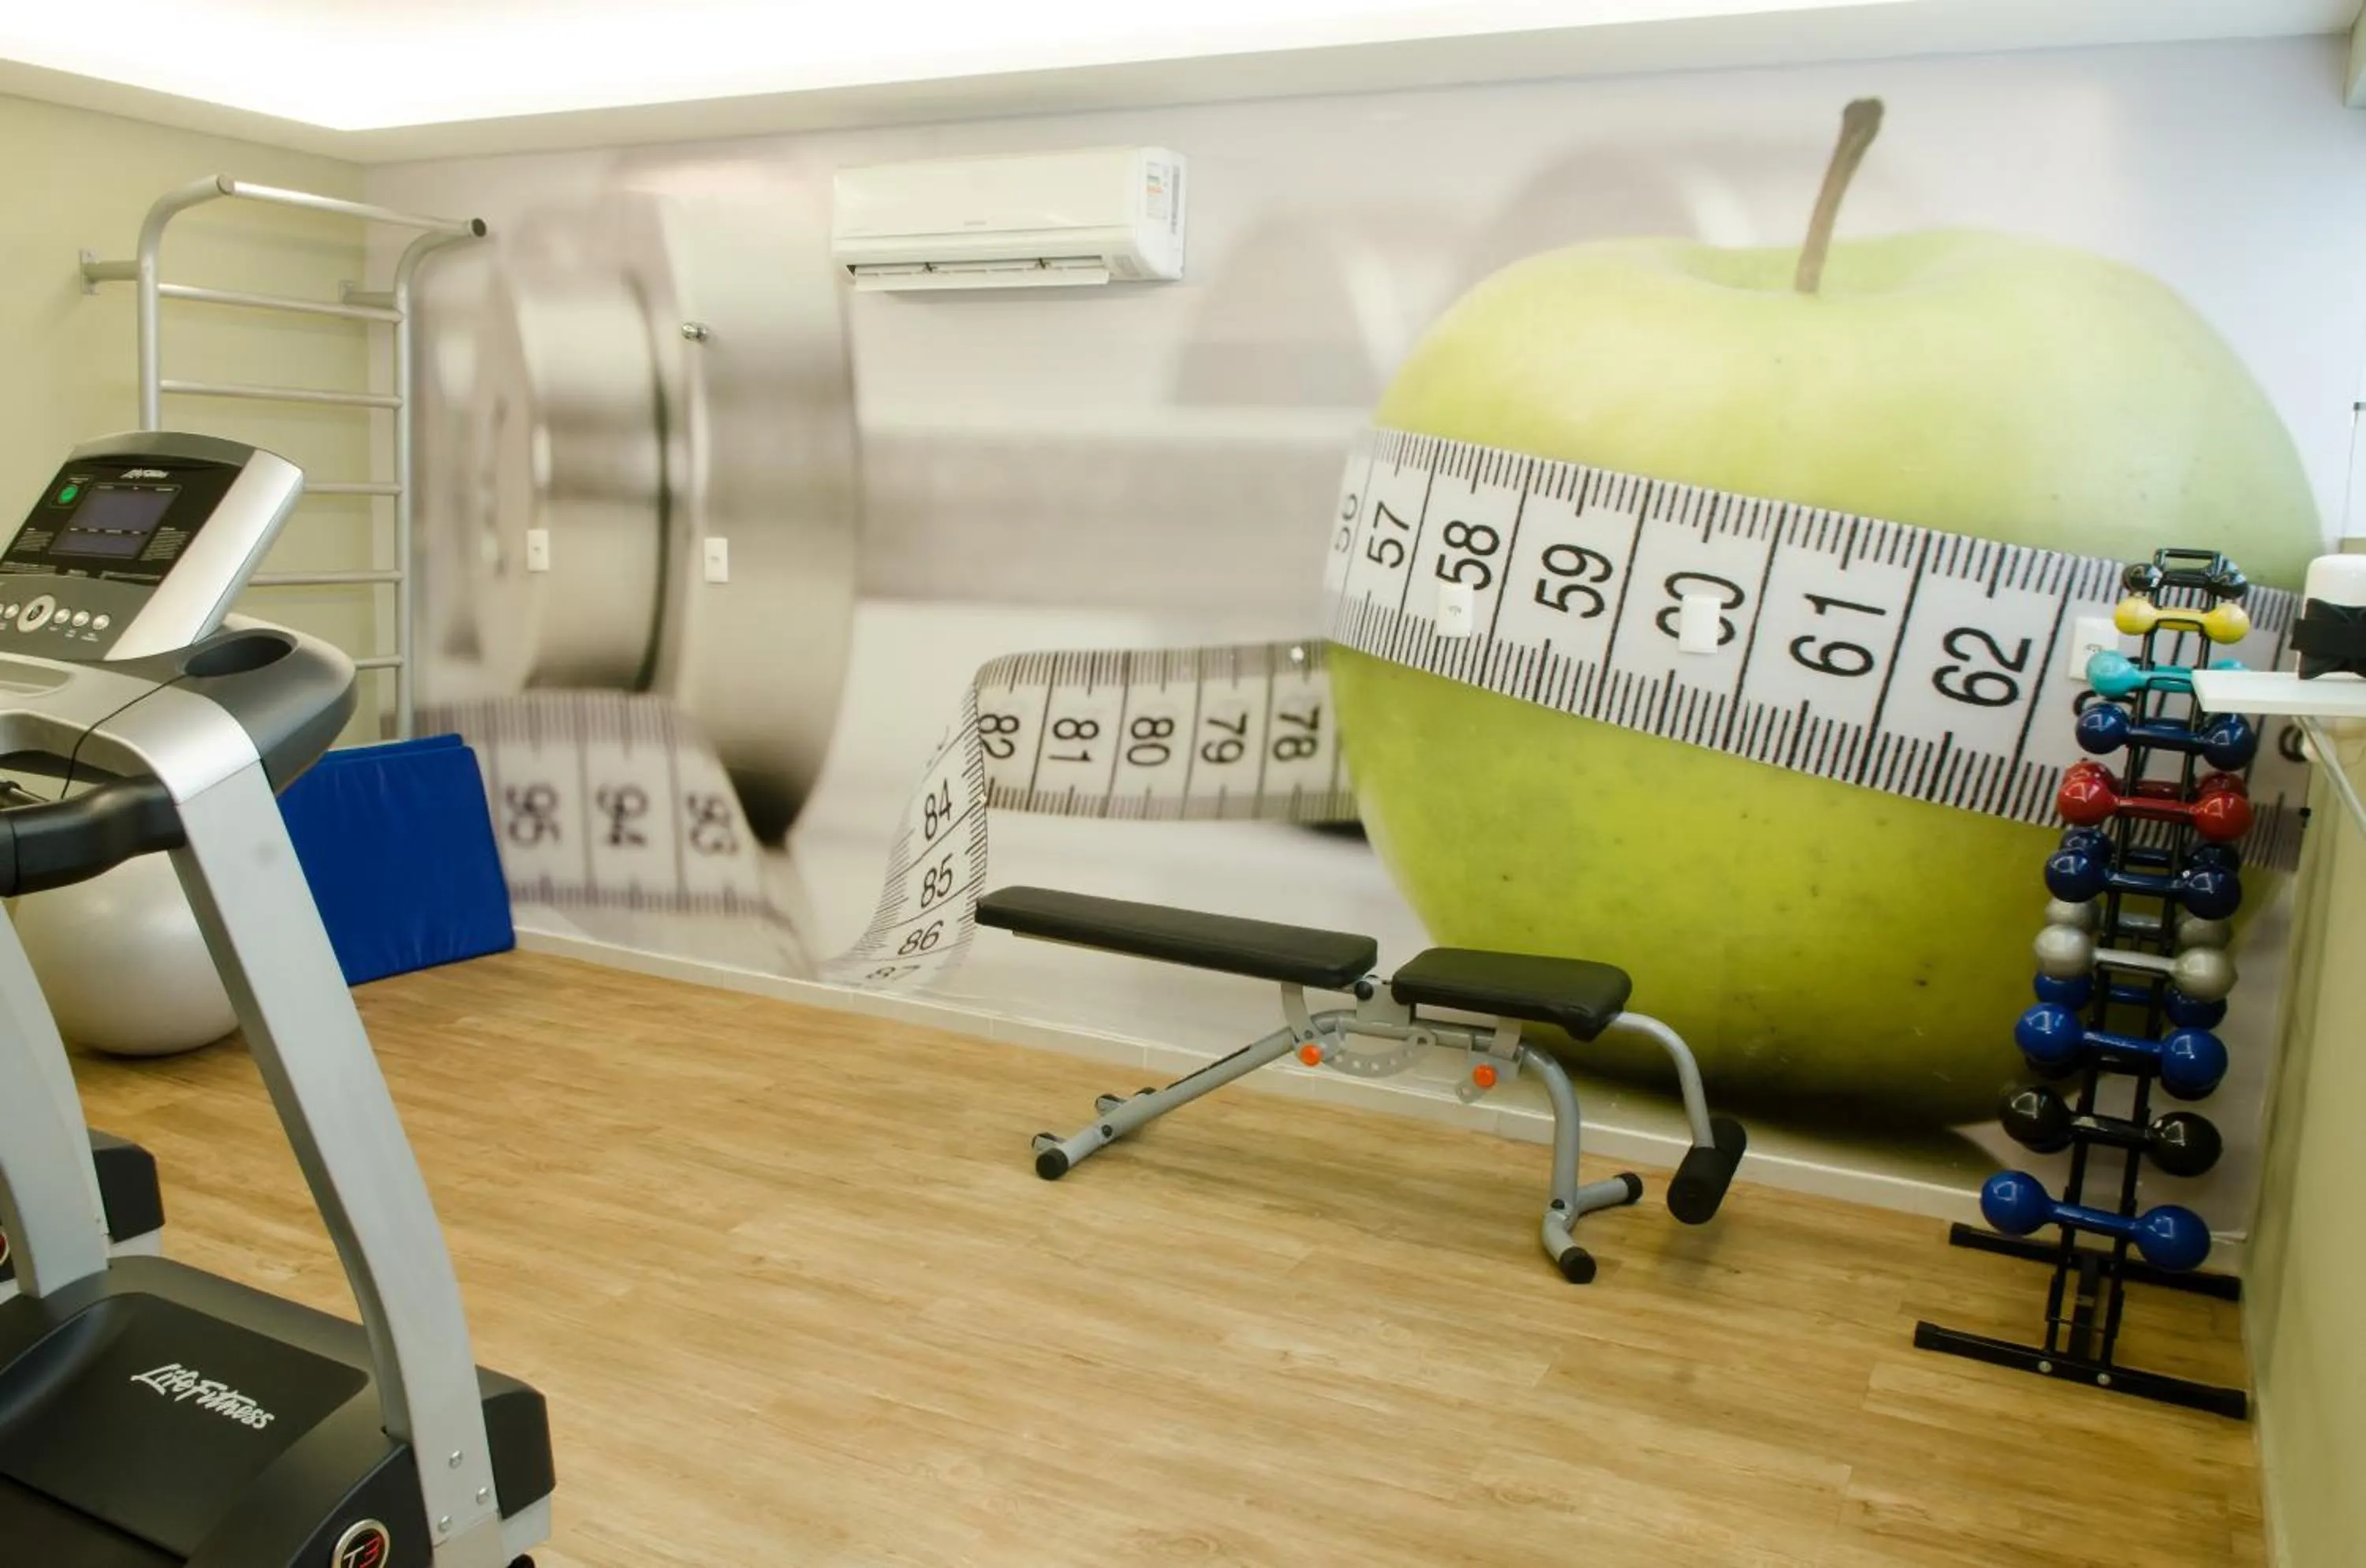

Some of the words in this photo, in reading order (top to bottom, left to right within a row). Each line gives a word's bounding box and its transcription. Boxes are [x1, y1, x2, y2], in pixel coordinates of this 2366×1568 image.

[1367, 501, 1410, 569] 57
[1435, 520, 1500, 591] 58
[1534, 544, 1613, 618] 59
[1789, 592, 1886, 677] 61
[1932, 627, 2032, 707] 62
[979, 713, 1020, 759] 82
[1049, 717, 1099, 763] 81
[1127, 716, 1175, 767] 80
[1201, 712, 1248, 764] 79
[1272, 704, 1321, 762] 78
[596, 783, 647, 846] 94
[924, 778, 953, 841] 84
[920, 853, 953, 909] 85
[898, 920, 945, 956] 86
